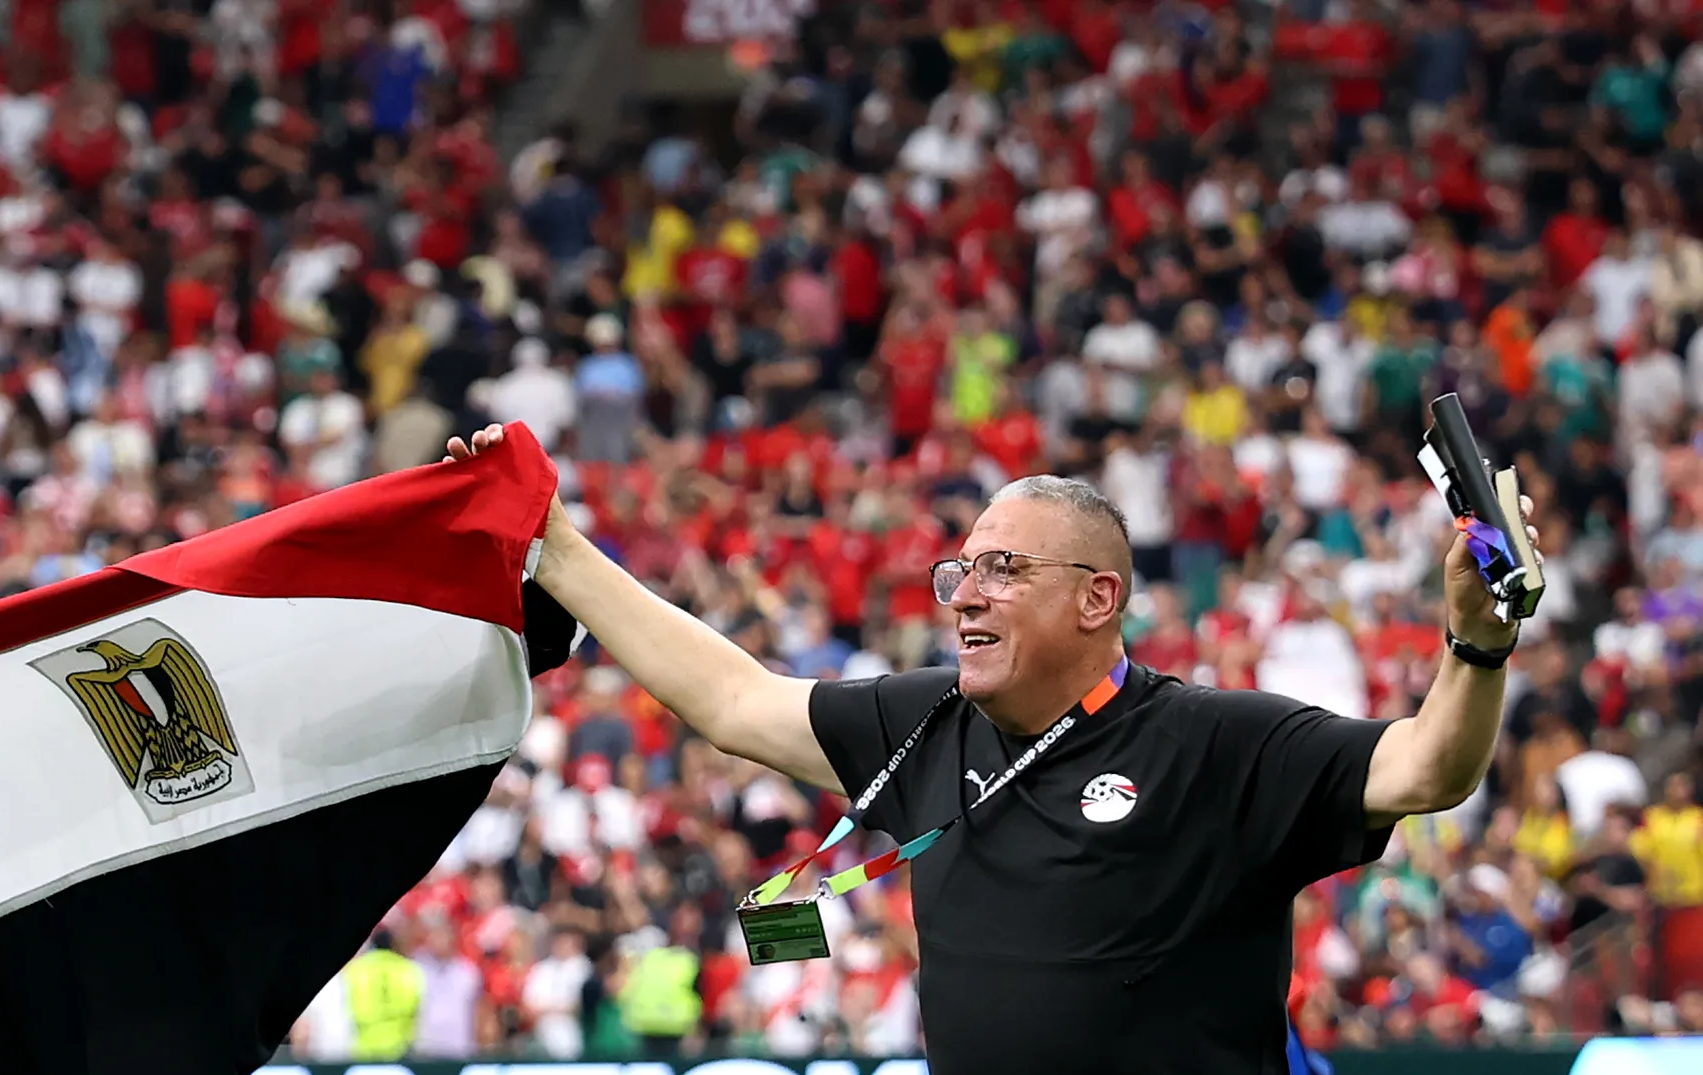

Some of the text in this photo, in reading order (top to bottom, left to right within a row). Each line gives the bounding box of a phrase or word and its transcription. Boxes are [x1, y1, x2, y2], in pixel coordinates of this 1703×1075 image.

[904, 709, 935, 748] ORLD
[1014, 748, 1037, 772] CUP
[1034, 715, 1076, 754] 2026
[888, 748, 907, 772] CUP
[855, 769, 890, 810] 2026
